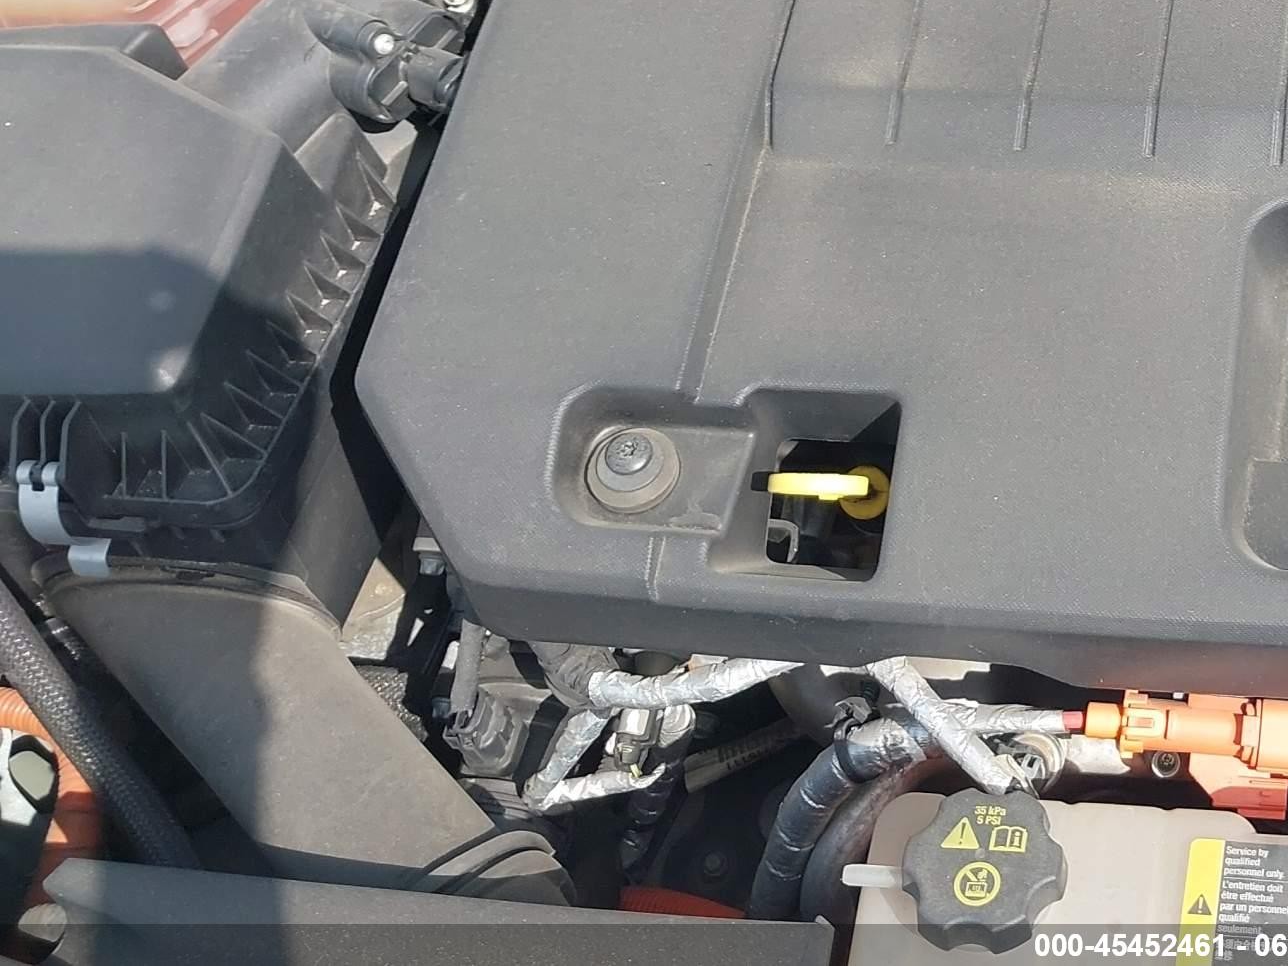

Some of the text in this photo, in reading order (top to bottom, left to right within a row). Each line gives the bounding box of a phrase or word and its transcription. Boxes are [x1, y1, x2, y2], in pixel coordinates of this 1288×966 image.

[974, 805, 1007, 817] 35 kPa
[976, 815, 1002, 826] 5 PSI
[1226, 845, 1269, 858] Service by
[1224, 857, 1261, 867] qualified
[1223, 867, 1265, 878] personnel
[1266, 884, 1284, 893] doit
[1239, 892, 1274, 903] effectué
[1219, 902, 1235, 912] par
[1235, 904, 1247, 912] un
[1218, 913, 1251, 923] qualifié
